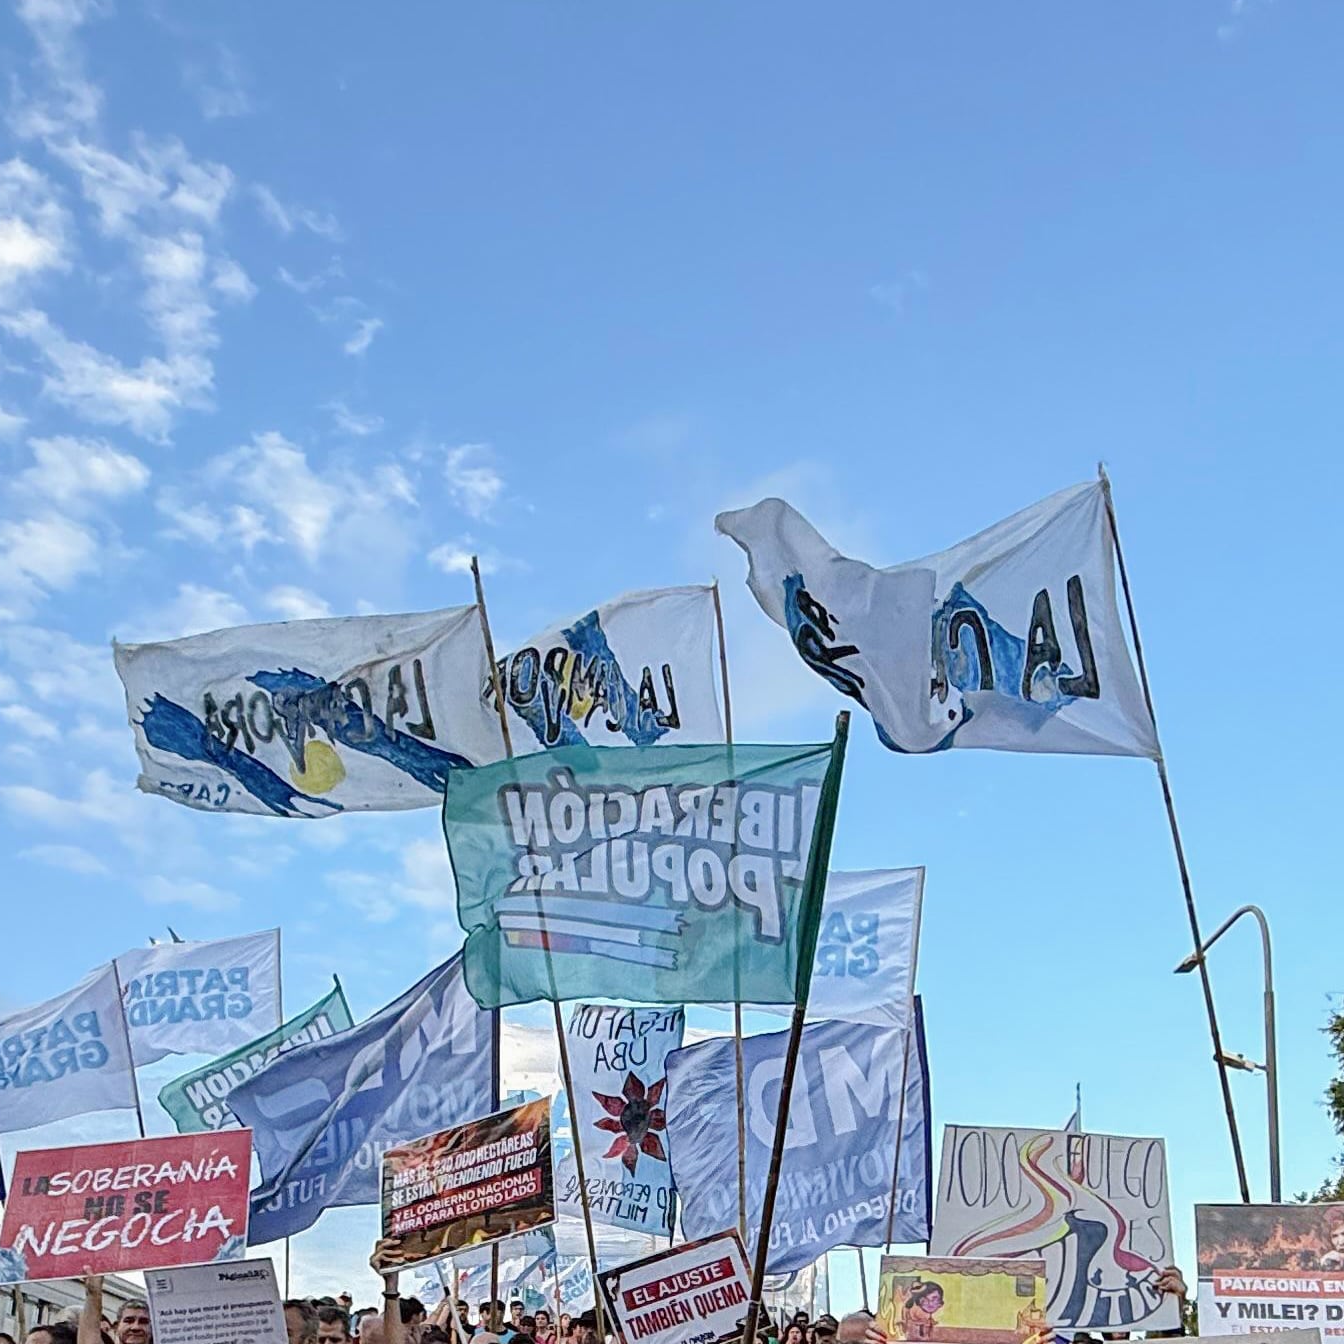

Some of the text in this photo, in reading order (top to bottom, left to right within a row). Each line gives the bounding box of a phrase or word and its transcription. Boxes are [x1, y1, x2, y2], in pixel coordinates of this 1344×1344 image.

[22, 1149, 239, 1197] LA SOBERANÍA
[392, 1191, 405, 1207] SE
[440, 1158, 503, 1191] PRENDIENDO
[504, 1148, 538, 1172] FUEGO
[1067, 1134, 1164, 1208] FUEGO
[133, 1189, 170, 1216] SE
[394, 1211, 403, 1221] Y
[403, 1208, 416, 1219] EL
[477, 1171, 537, 1196] NACIONAL
[424, 1207, 454, 1225] PARA
[456, 1203, 470, 1216] EL
[470, 1192, 503, 1214] OTRO
[504, 1183, 537, 1201] LADO
[13, 1205, 234, 1257] NEGOCIA
[632, 1262, 724, 1306] EL AJUSTE
[1221, 1277, 1321, 1292] PATAGONIA
[625, 1280, 749, 1341] TAMBIÉN QUEMA
[1215, 1303, 1232, 1318] Y
[1238, 1303, 1319, 1321] MILEI?
